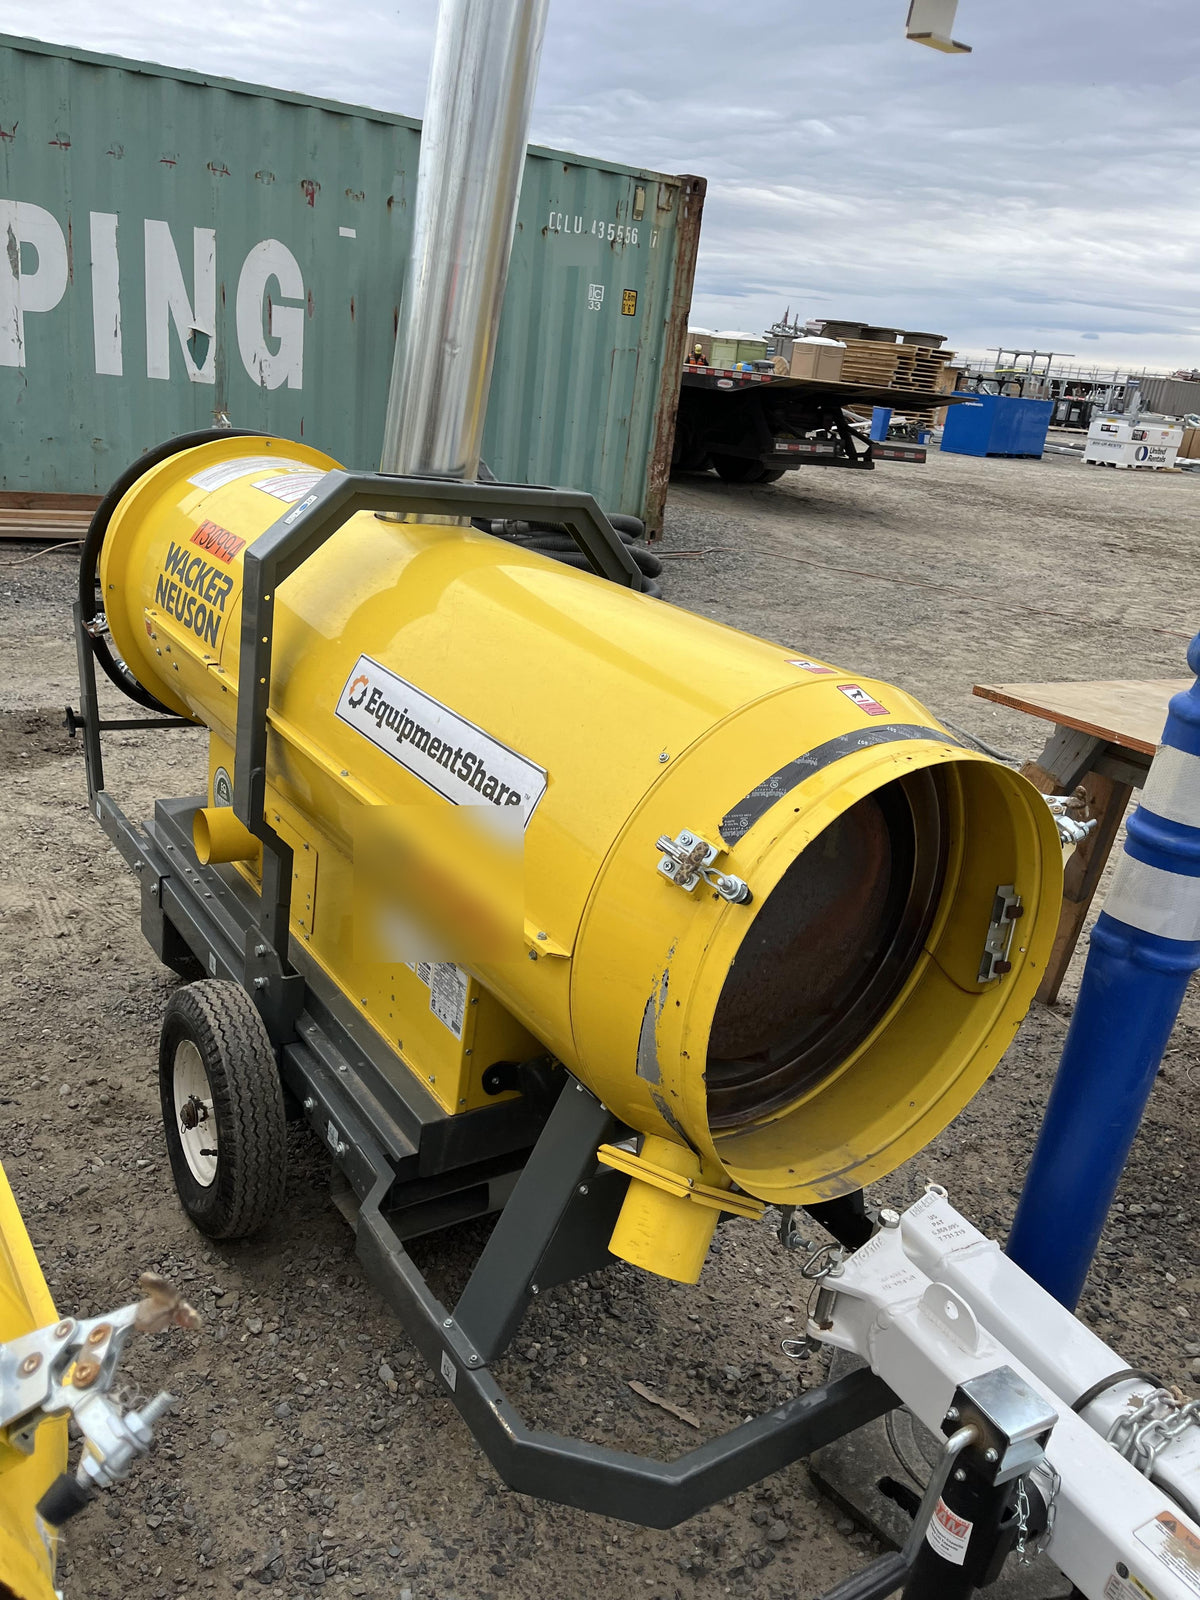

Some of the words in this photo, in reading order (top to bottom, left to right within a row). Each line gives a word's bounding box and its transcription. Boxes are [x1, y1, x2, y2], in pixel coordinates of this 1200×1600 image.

[549, 212, 582, 233] CCLU
[591, 220, 638, 245] 435556
[0, 198, 304, 390] PING
[588, 301, 601, 311] 33
[1148, 454, 1166, 463] Rentals
[1149, 446, 1167, 455] United
[193, 520, 245, 563] 130994
[164, 541, 234, 613] WACKER
[155, 573, 222, 649] NEUSON
[364, 686, 522, 806] EquipmentShare
